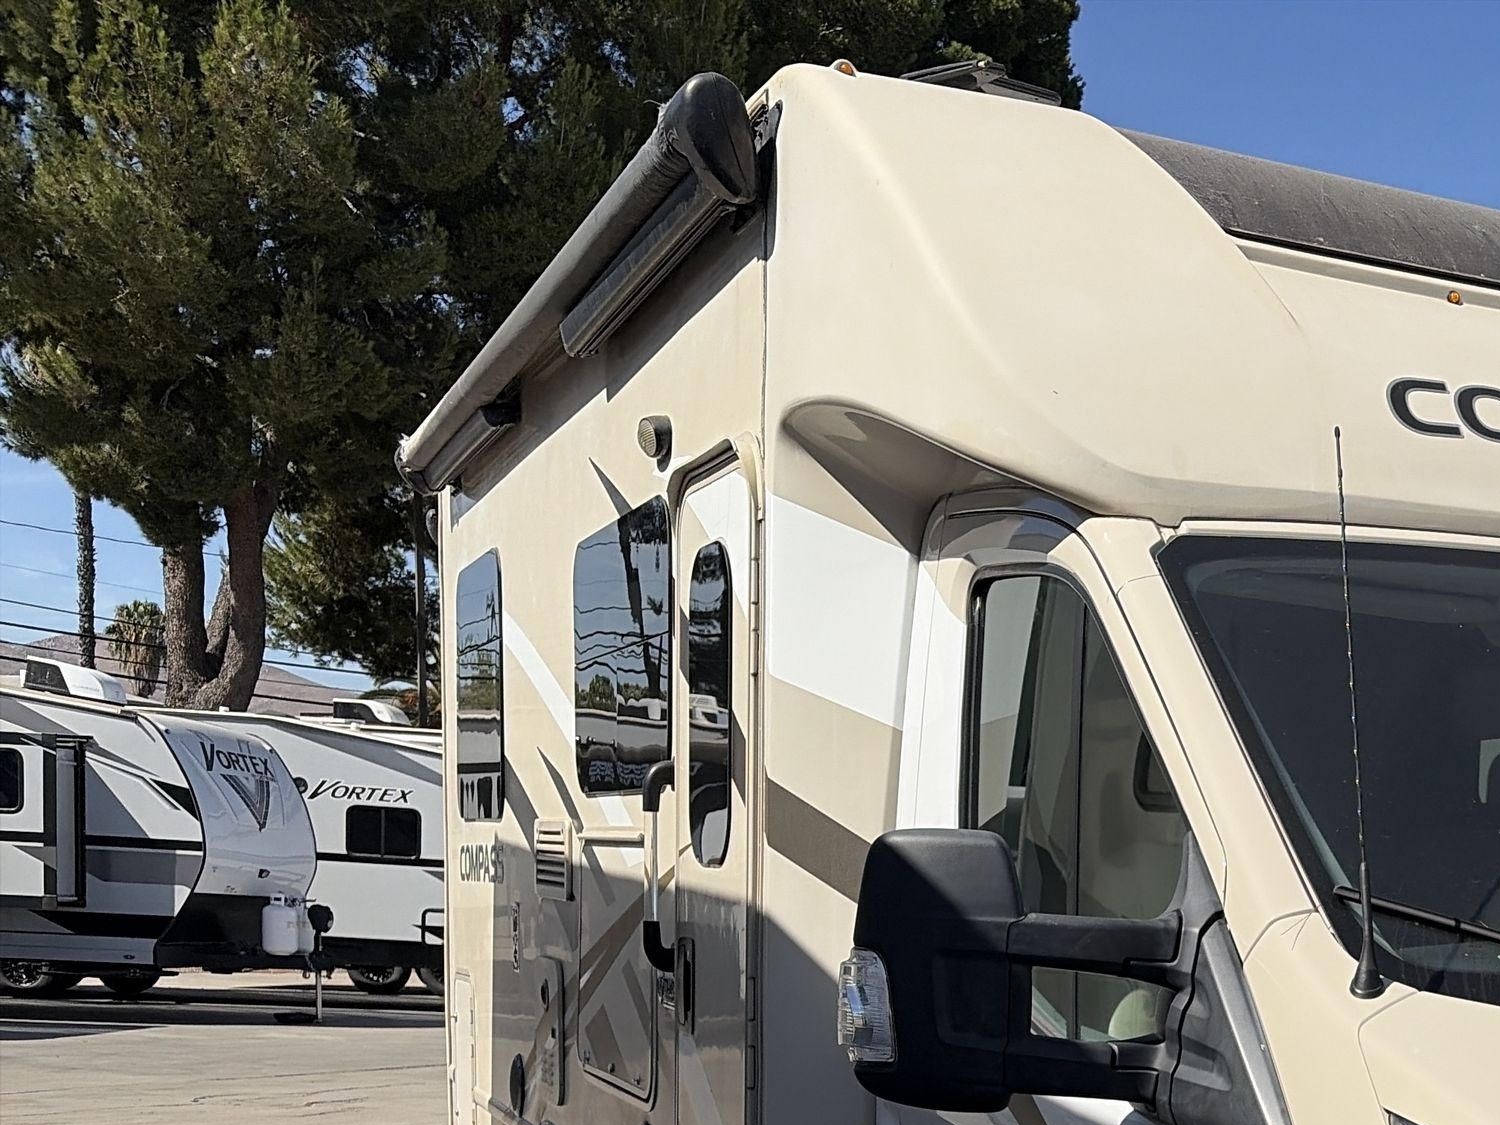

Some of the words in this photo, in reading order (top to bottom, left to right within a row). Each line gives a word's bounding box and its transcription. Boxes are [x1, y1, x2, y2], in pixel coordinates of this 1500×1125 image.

[200, 741, 276, 777] VORTEX
[307, 779, 414, 804] VORTEX
[460, 844, 505, 884] COMPASS
